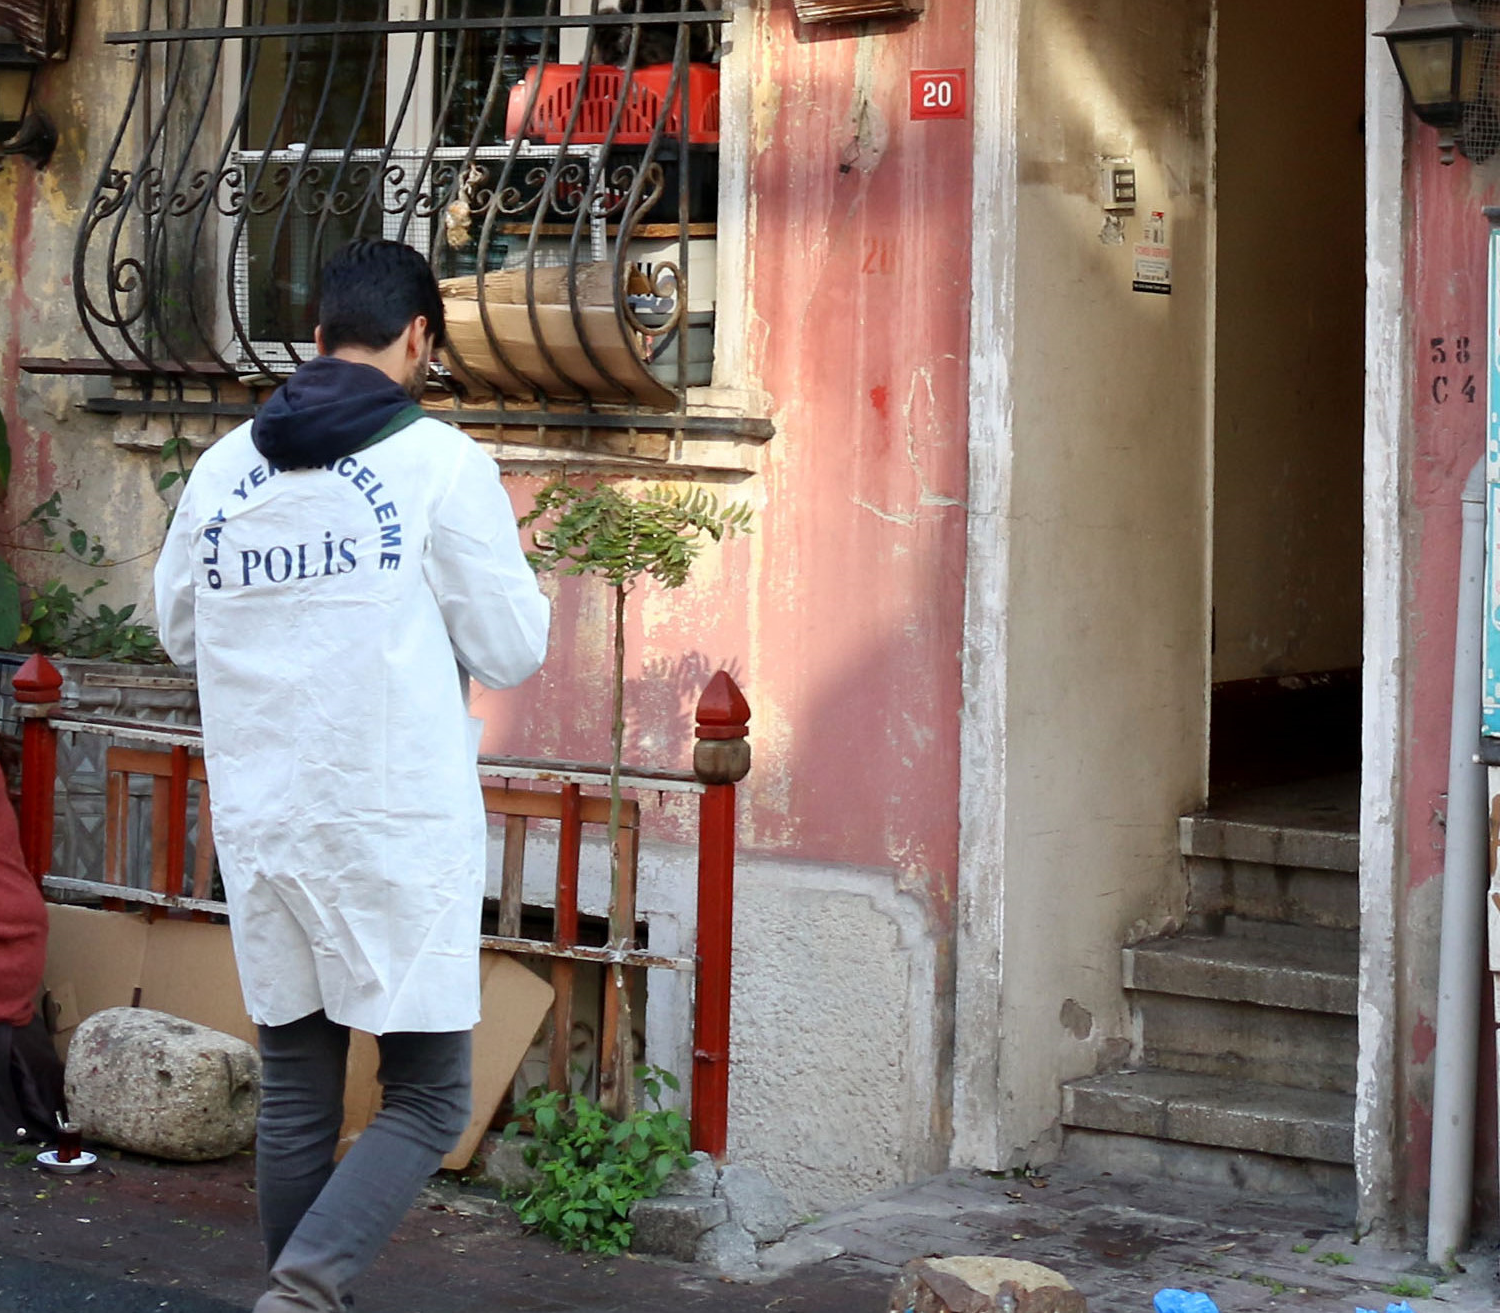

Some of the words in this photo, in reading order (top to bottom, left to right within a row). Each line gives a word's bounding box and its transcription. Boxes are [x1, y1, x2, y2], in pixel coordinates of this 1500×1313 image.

[923, 81, 952, 107] 20
[1431, 374, 1477, 405] C4
[203, 508, 227, 590] OLAY
[312, 456, 402, 571] CELEME
[239, 531, 357, 586] POLİS
